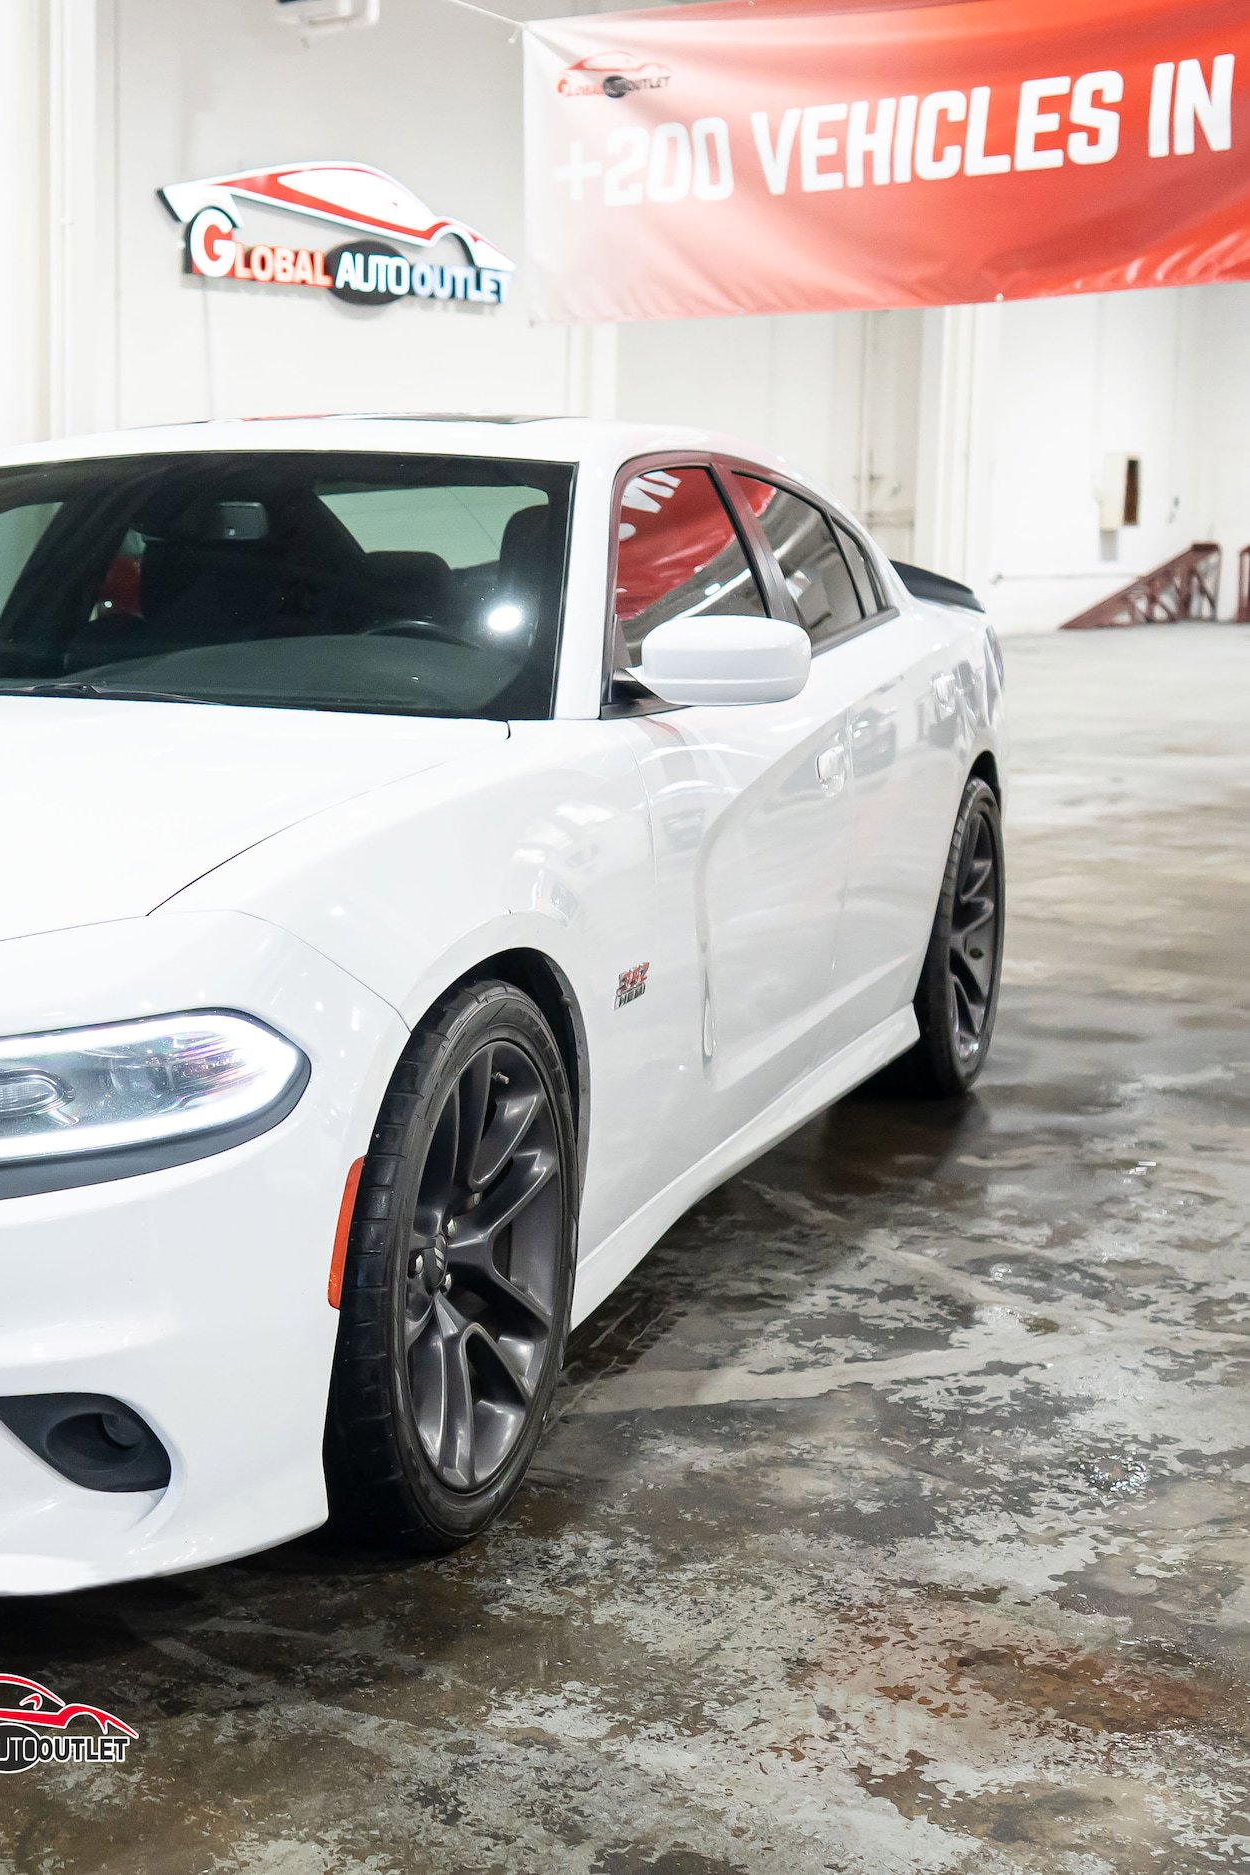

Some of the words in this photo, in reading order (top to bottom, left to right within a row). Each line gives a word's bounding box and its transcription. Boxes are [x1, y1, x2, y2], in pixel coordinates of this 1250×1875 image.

[552, 116, 735, 207] +200
[750, 70, 1124, 196] VEHICLES
[1148, 54, 1235, 158] IN
[190, 208, 333, 288] GLOBAL
[335, 251, 411, 295] AUTO
[412, 262, 512, 304] OUTLET
